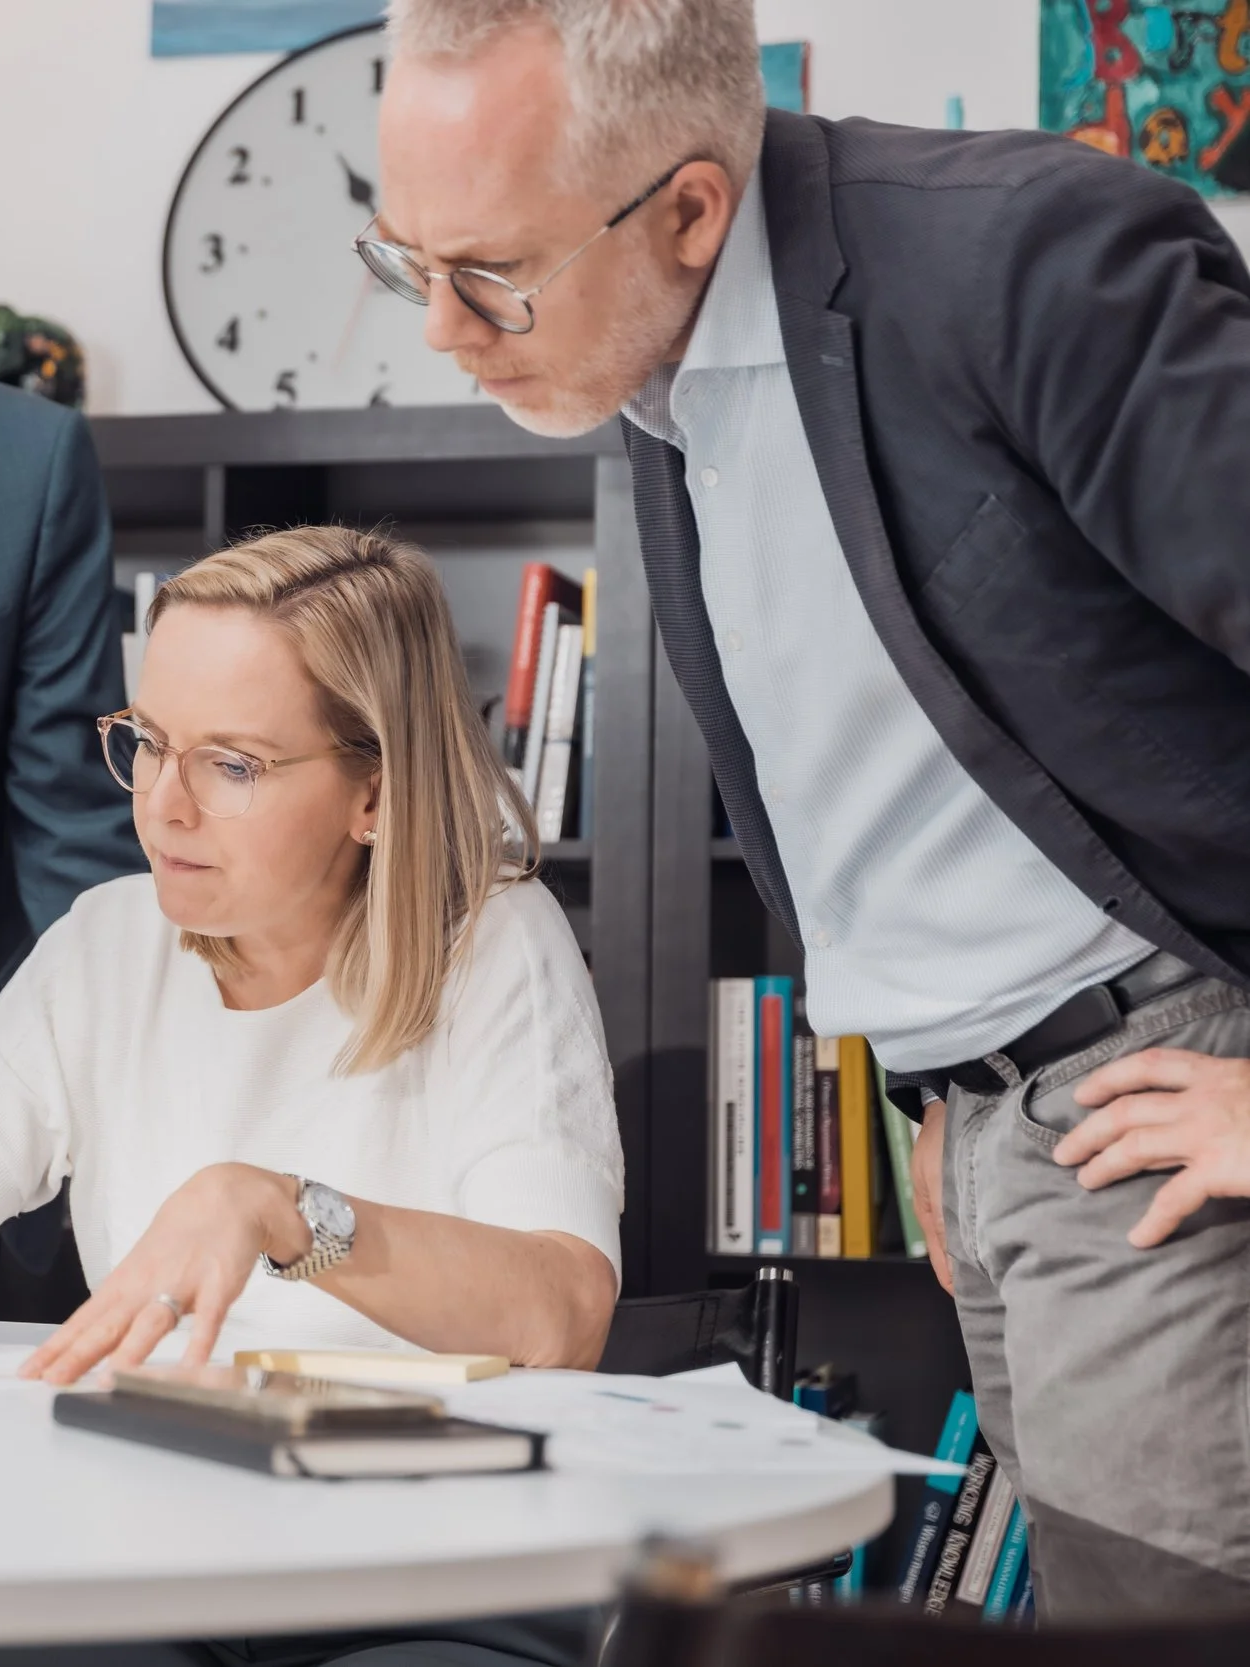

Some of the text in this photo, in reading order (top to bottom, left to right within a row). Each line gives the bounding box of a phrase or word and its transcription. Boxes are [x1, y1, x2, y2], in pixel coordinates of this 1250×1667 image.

[291, 87, 306, 125] 1
[226, 145, 251, 187] 2
[199, 232, 225, 274] 3
[214, 315, 241, 354] 4
[273, 369, 299, 409] 5
